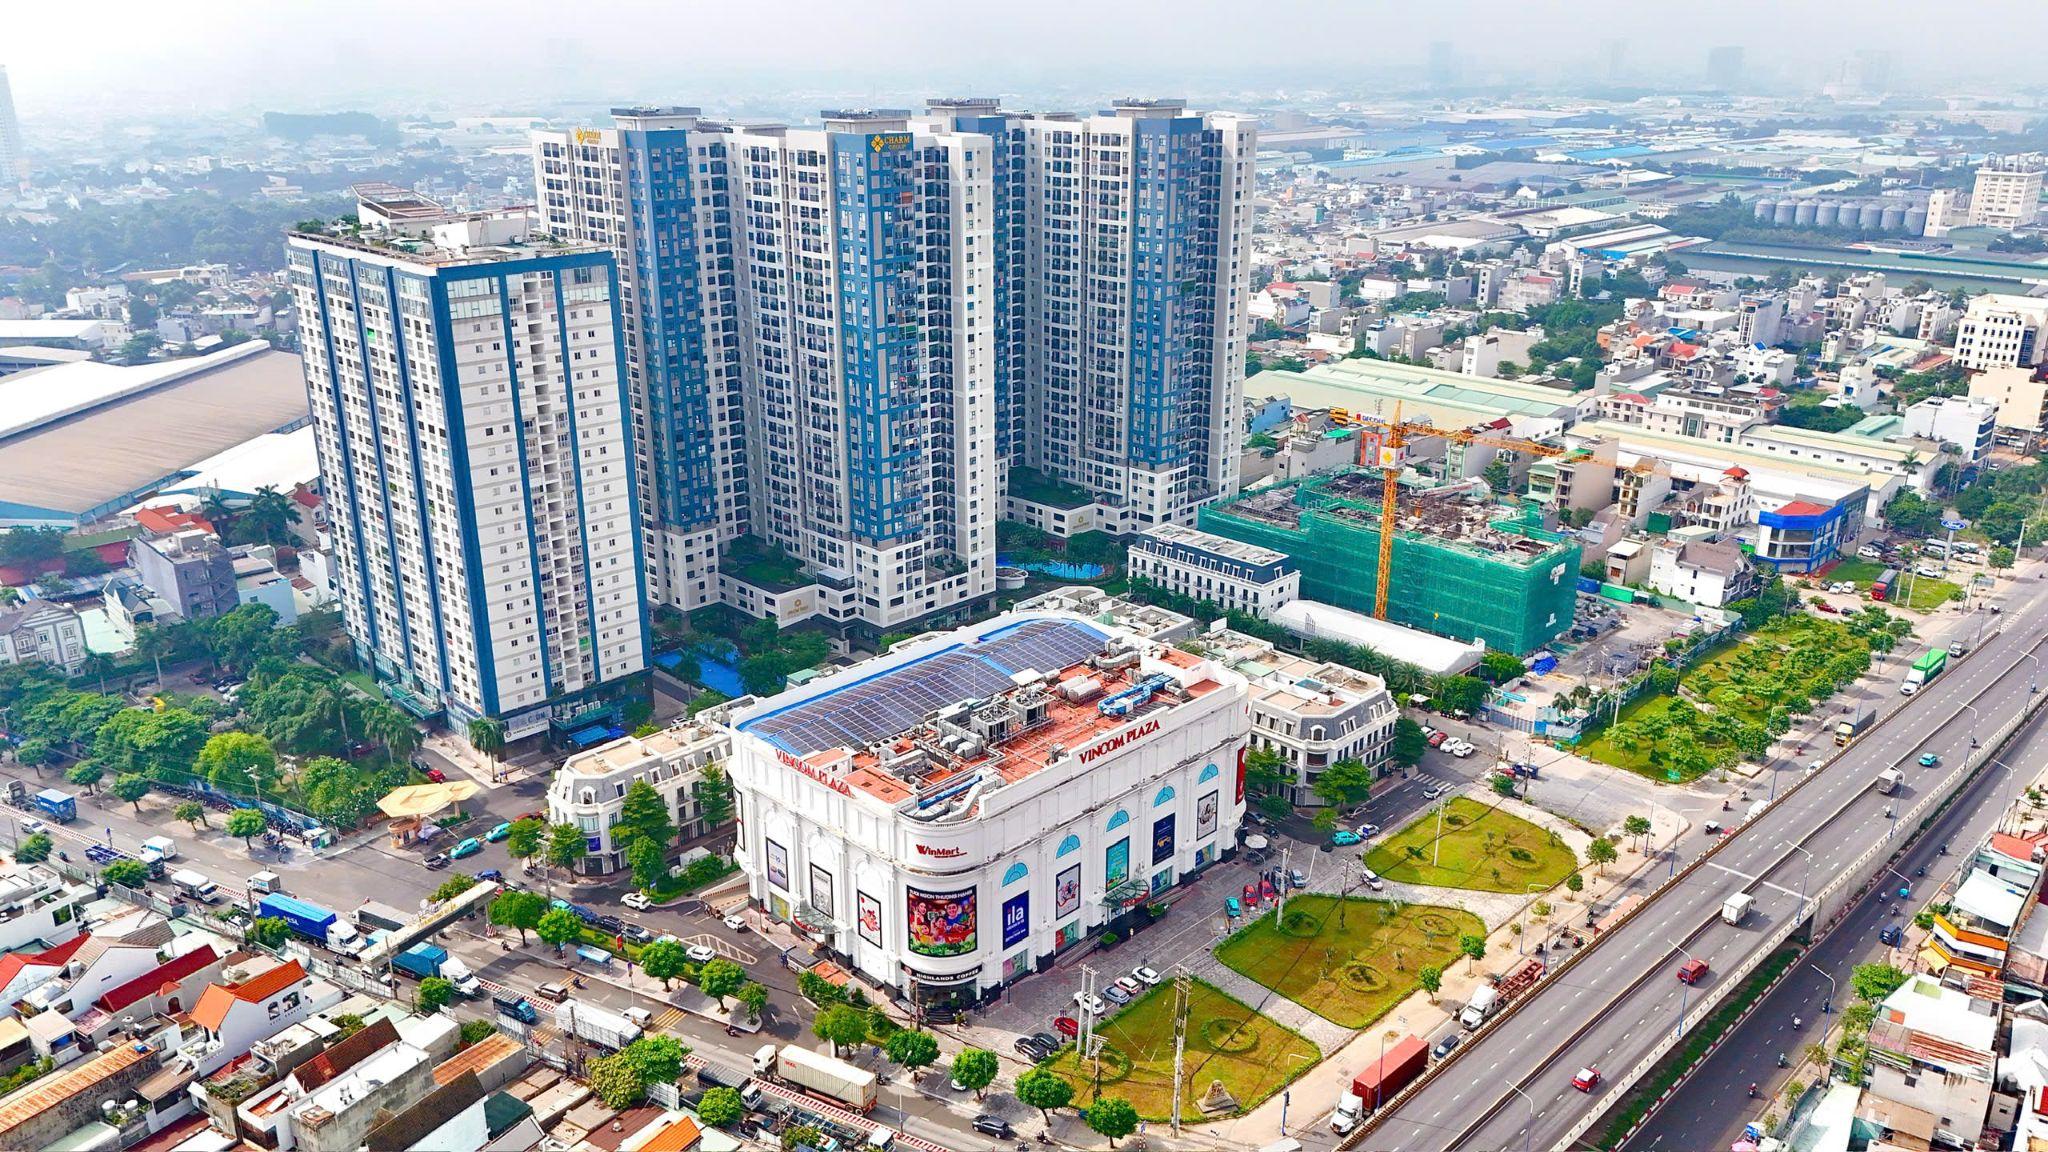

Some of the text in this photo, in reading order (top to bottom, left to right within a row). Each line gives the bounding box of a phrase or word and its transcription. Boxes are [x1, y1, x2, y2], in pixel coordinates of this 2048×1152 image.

[884, 135, 910, 145] CHARM
[1078, 719, 1160, 765] VINCOM PLAZA
[775, 748, 857, 799] VINCOM PLAZA
[915, 844, 962, 857] WinMart
[1007, 905, 1024, 926] ila
[916, 968, 979, 981] HIGHLANDS COFFEE
